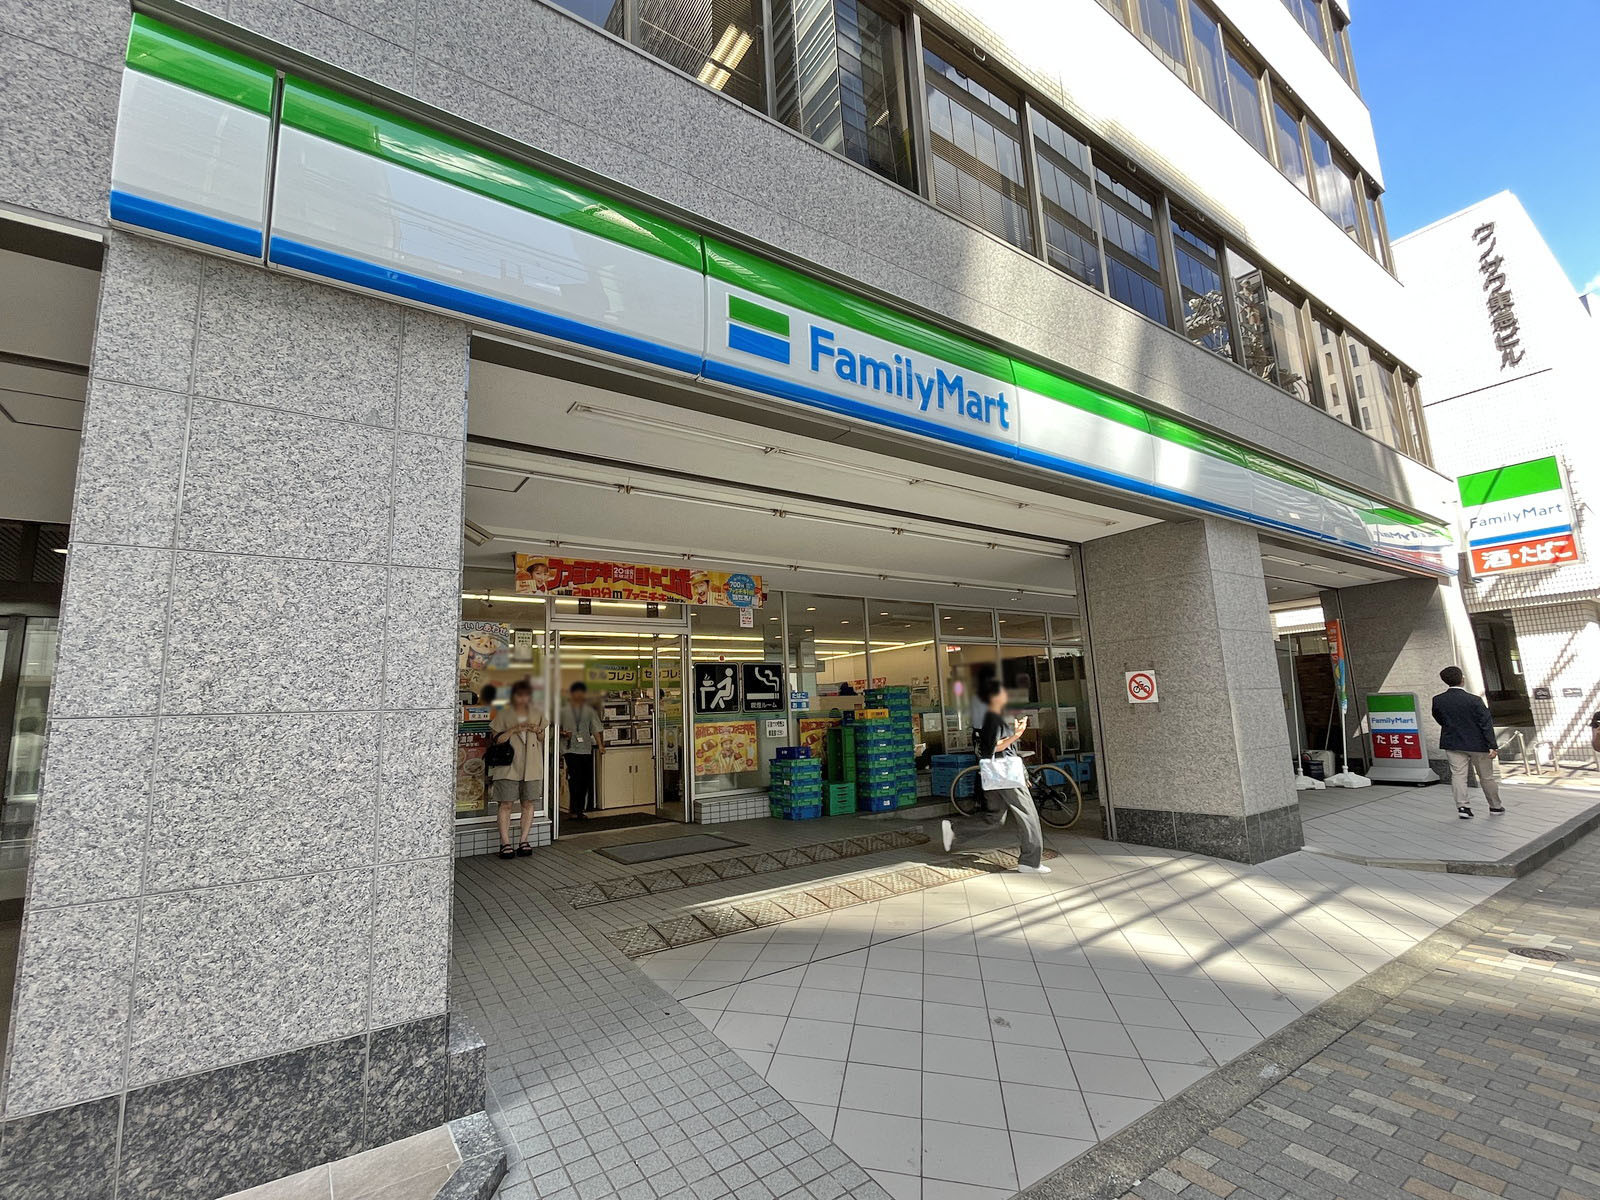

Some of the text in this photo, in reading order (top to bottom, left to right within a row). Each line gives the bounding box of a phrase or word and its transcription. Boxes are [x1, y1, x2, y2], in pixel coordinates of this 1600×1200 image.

[1472, 222, 1525, 371] ウノサワ東急ビル
[809, 323, 1009, 429] FamilyMart
[1470, 504, 1562, 528] FamilyMart
[1481, 540, 1572, 569] 酒・たばこ
[1371, 717, 1414, 725] FamilyMart
[1376, 734, 1414, 745] たばこ
[1389, 747, 1403, 758] 酒
